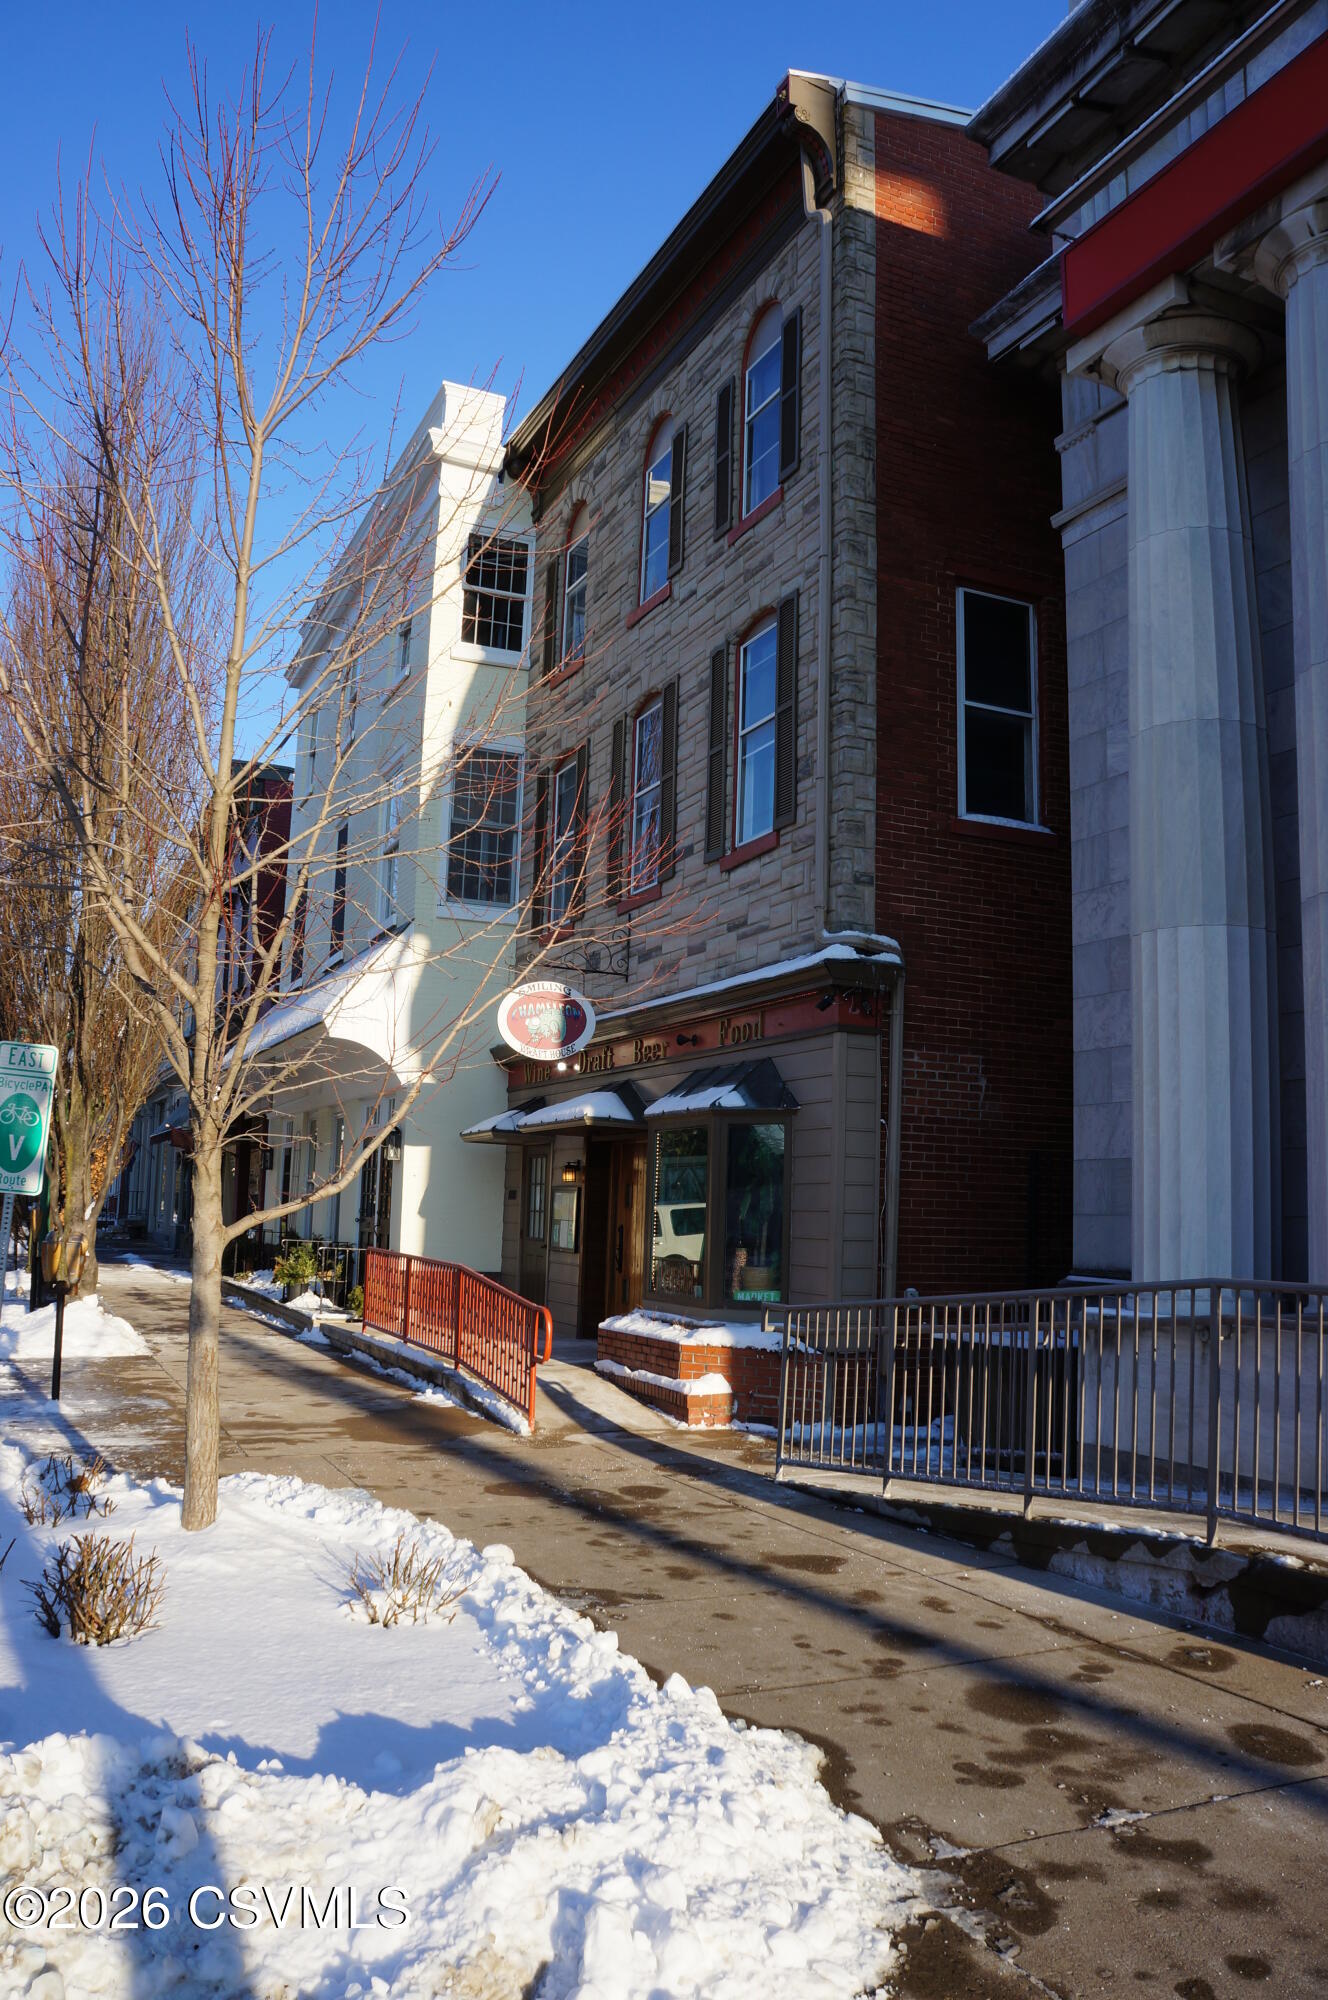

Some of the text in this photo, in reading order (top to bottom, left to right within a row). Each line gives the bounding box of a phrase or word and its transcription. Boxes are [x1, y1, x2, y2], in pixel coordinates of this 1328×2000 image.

[518, 983, 572, 997] SMILING
[8, 1046, 45, 1069] EAST
[520, 1043, 577, 1059] DRAFT HOUSE
[523, 1011, 764, 1083] Wine Draft Beer Food
[9, 1134, 25, 1161] V
